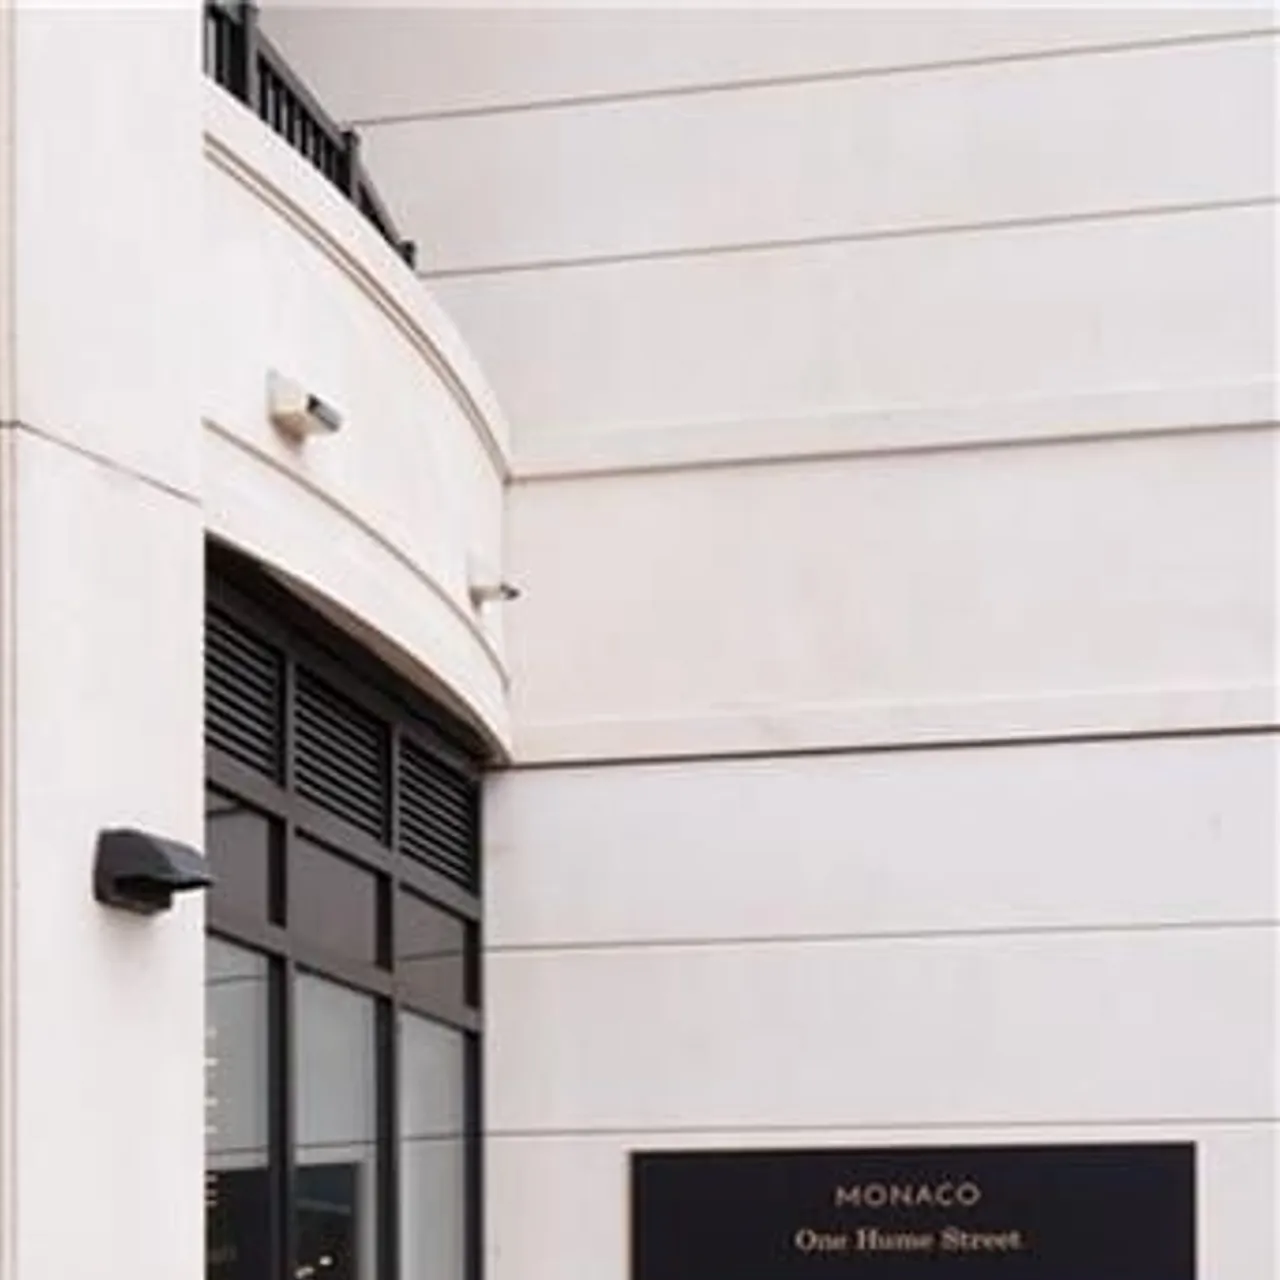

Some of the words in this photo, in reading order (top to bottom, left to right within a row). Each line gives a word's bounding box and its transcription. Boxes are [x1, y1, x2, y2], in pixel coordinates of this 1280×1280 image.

[835, 1182, 982, 1207] MONACO
[794, 1228, 847, 1251] One
[855, 1228, 936, 1250] Hume
[940, 1225, 1022, 1250] Street
